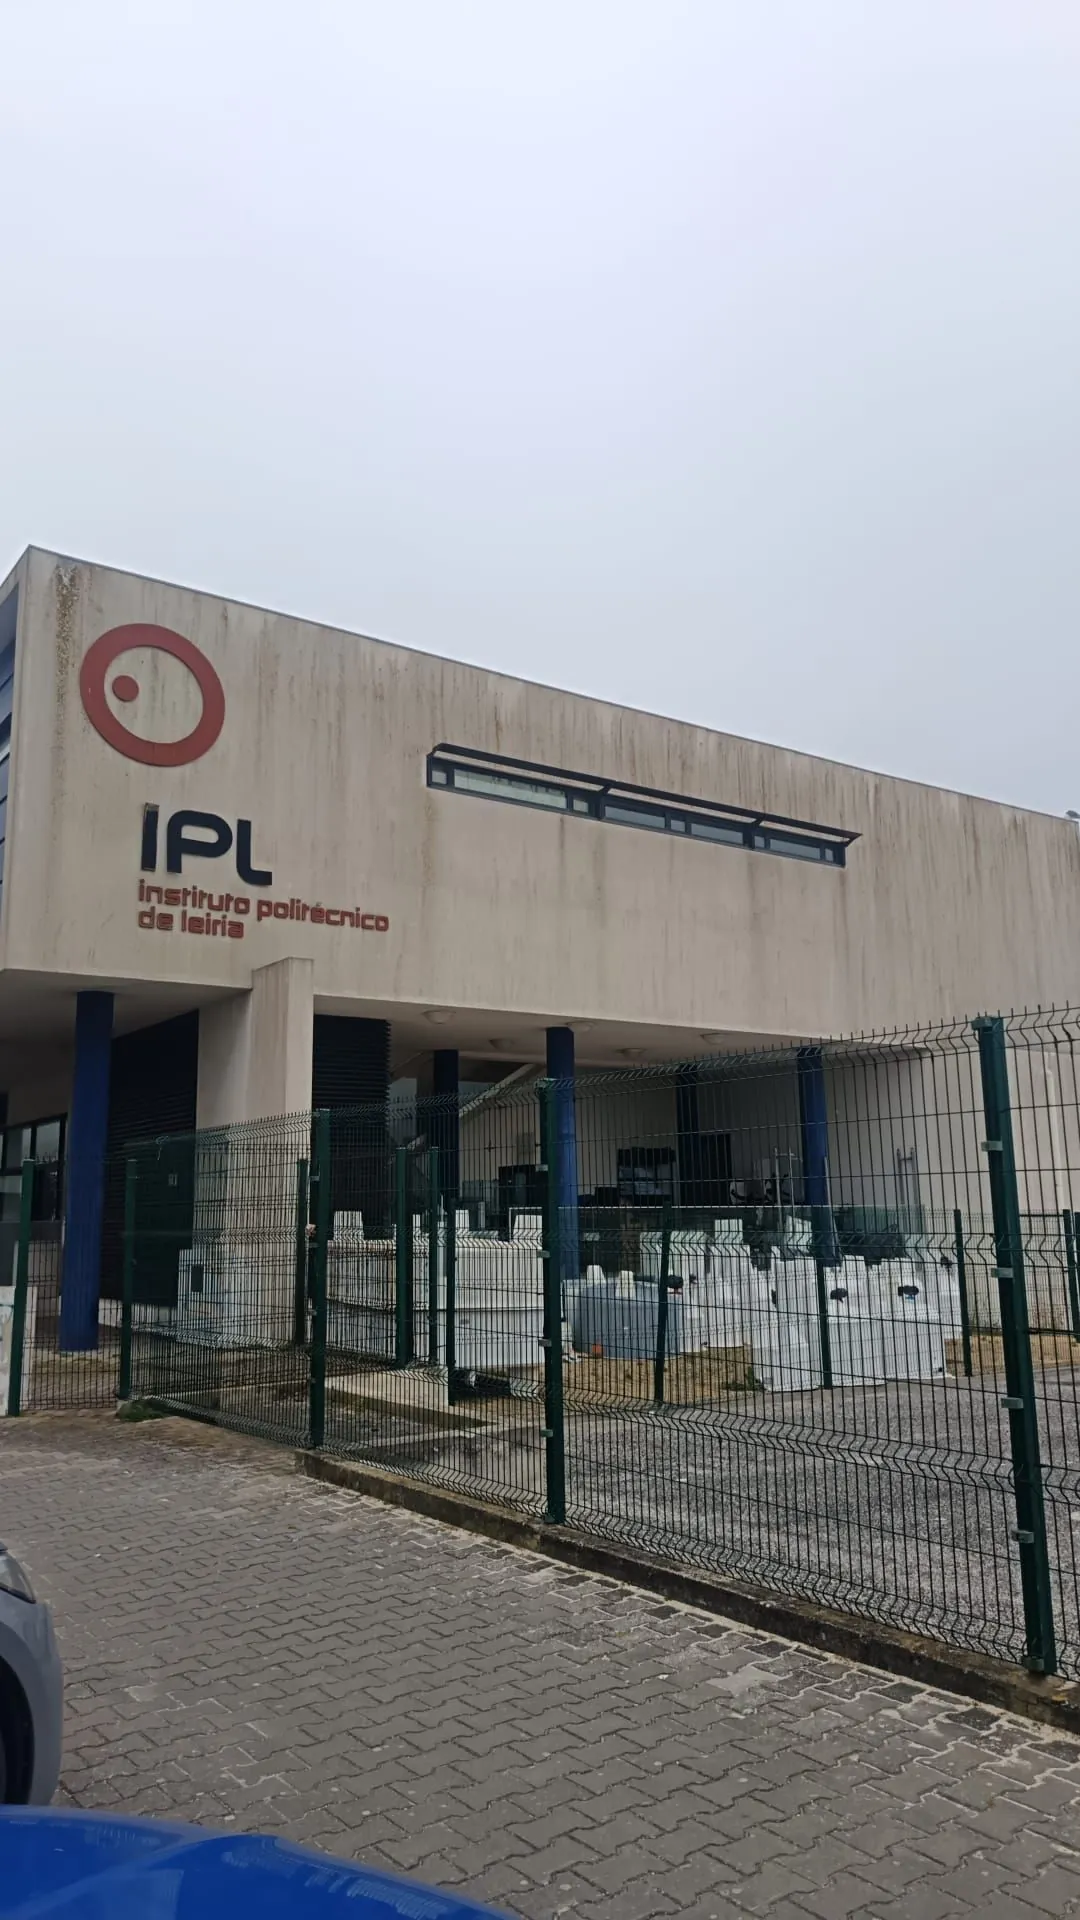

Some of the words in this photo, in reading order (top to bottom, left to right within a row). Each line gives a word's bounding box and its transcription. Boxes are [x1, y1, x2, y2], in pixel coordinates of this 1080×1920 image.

[141, 802, 272, 886] IPL
[138, 879, 250, 915] instituto
[138, 906, 174, 931] de
[181, 909, 244, 939] leiria
